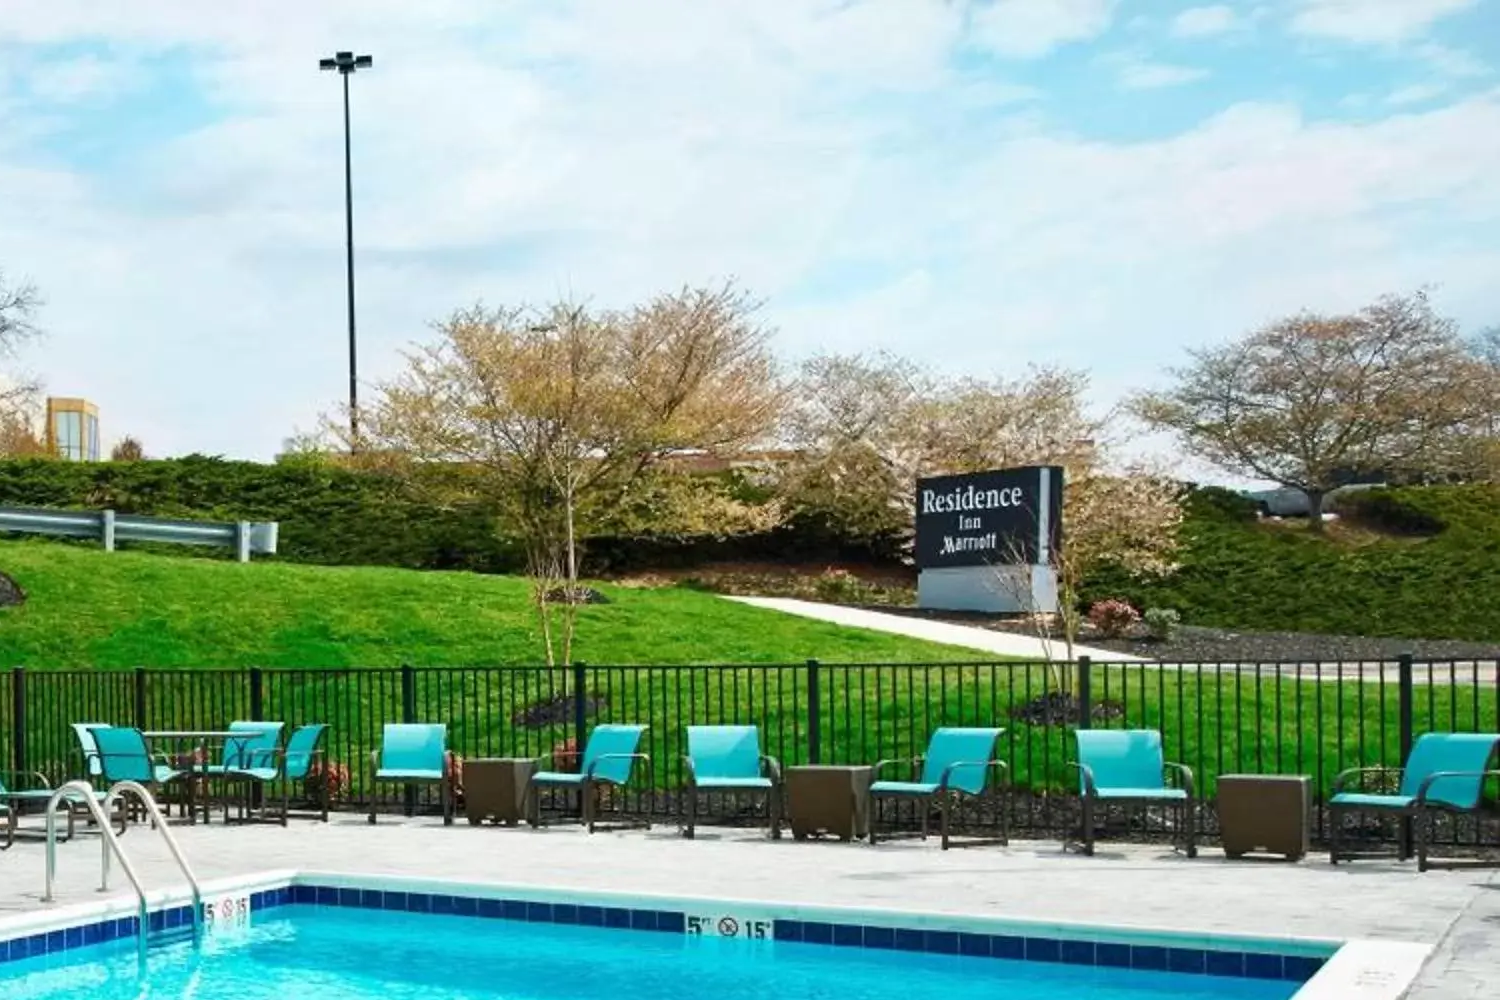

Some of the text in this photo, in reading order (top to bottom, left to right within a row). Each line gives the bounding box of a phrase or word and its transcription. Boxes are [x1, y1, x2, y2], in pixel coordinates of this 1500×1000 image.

[922, 485, 1023, 514] Residence
[959, 515, 982, 530] Inn
[939, 532, 997, 555] Marriott
